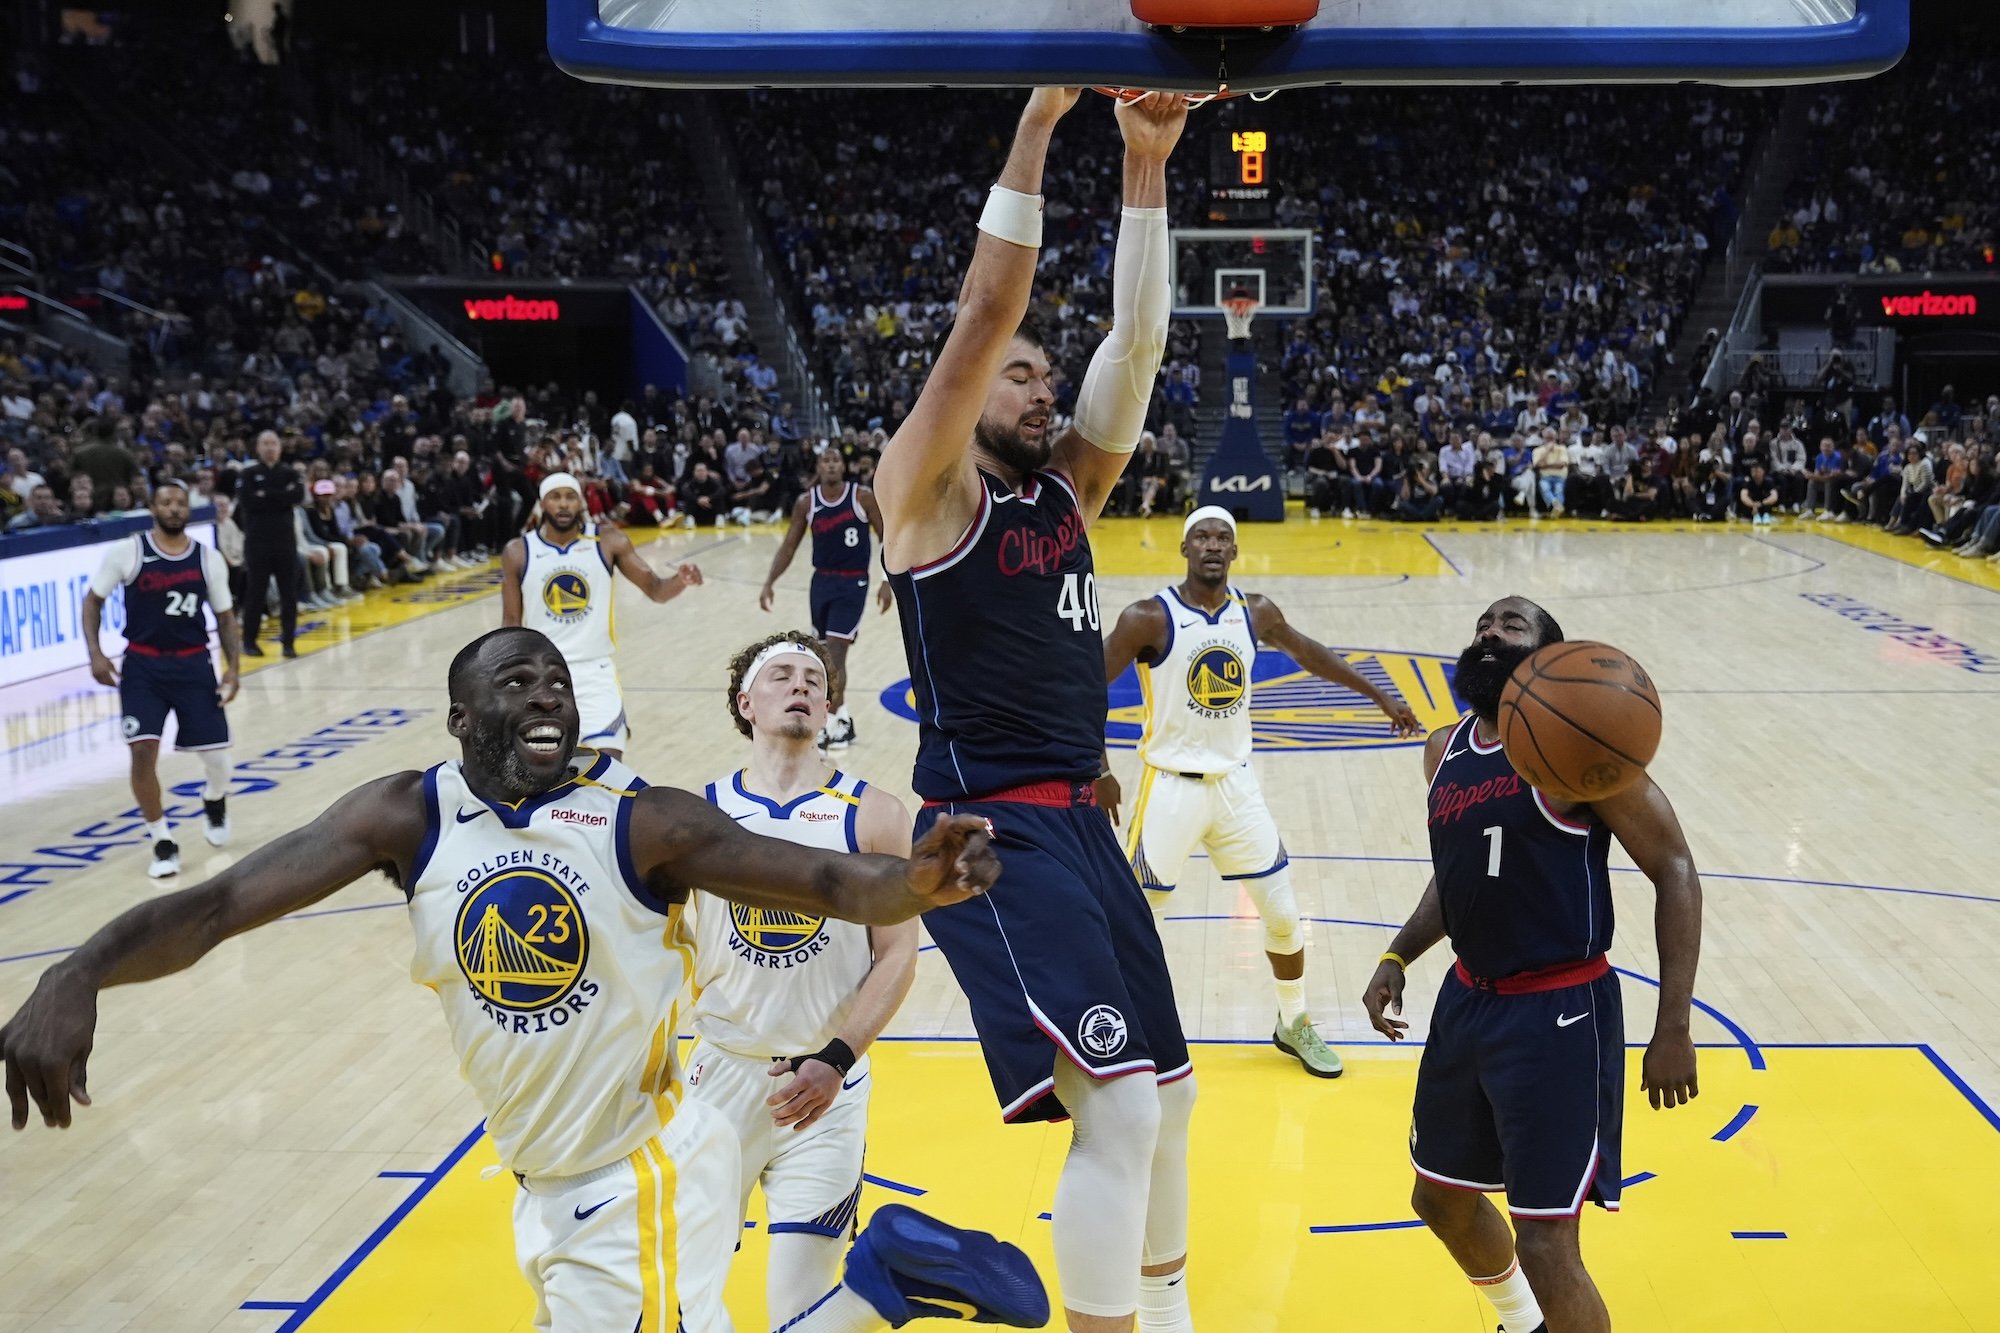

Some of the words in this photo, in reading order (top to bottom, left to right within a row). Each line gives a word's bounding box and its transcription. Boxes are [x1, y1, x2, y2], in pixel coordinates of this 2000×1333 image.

[1241, 152, 1263, 184] 8
[463, 294, 559, 320] verizon
[1881, 290, 1977, 316] verizon
[844, 527, 859, 547] 8
[165, 590, 199, 618] 24
[1057, 572, 1100, 631] 40
[1, 580, 65, 657] APRIL
[1187, 639, 1219, 662] GOLDEN
[1222, 639, 1244, 657] STATE
[1223, 660, 1240, 680] 10
[1187, 696, 1247, 720] WARRIOR
[1428, 772, 1522, 827] Clippers
[551, 809, 608, 827] Rakuten
[799, 810, 839, 822] Rakuten
[0, 806, 206, 905] HASE
[1483, 825, 1503, 878] 1
[457, 849, 534, 893] GOLDEN
[541, 853, 591, 896] STATE
[524, 904, 571, 944] 23
[728, 931, 831, 969] WARRIORS
